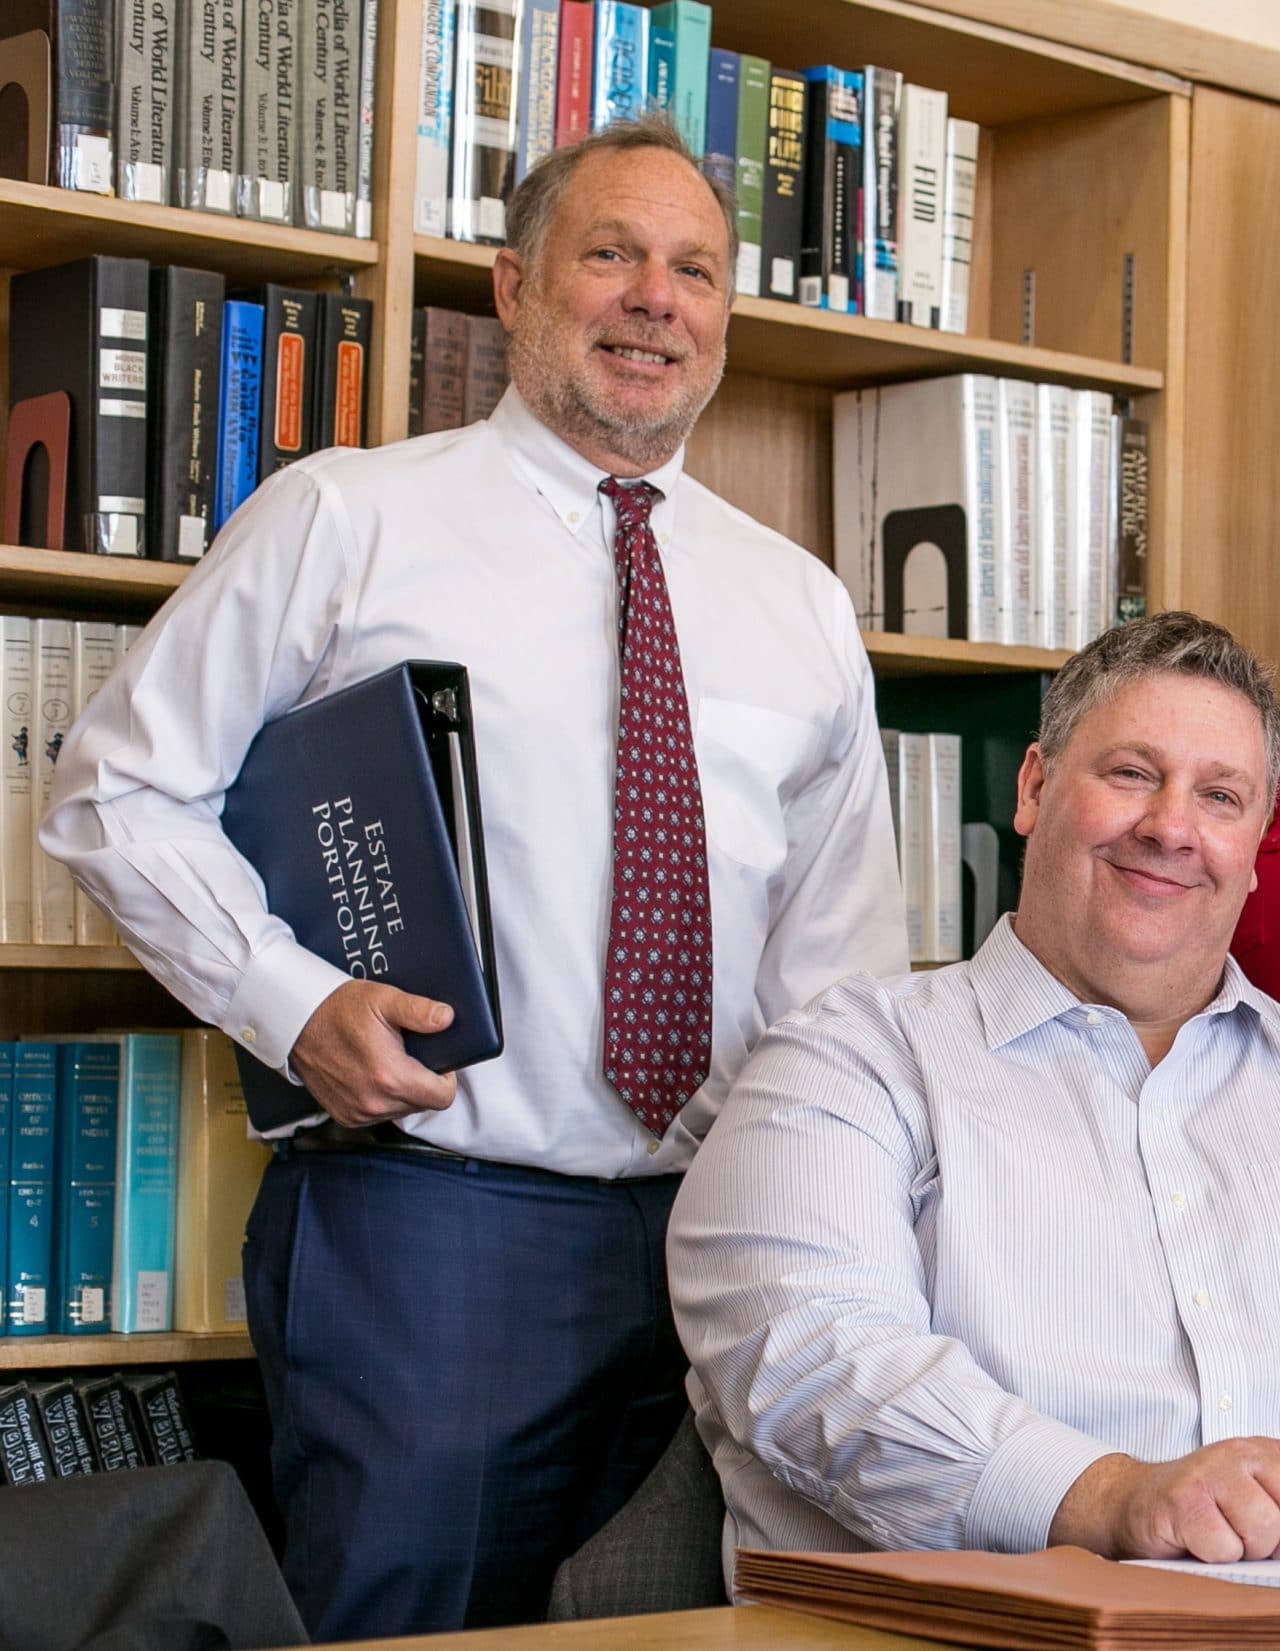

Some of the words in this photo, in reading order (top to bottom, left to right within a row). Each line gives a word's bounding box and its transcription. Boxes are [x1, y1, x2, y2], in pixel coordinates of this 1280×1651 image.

[152, 2, 168, 27] of
[223, 11, 237, 42] of
[278, 23, 292, 41] of
[312, 11, 330, 82] Century
[334, 34, 350, 55] of
[152, 28, 168, 84] World
[222, 39, 237, 91] World
[277, 44, 292, 98] World
[334, 58, 350, 109] World
[151, 86, 168, 167] Literatur
[222, 93, 236, 172] Literatur
[277, 101, 292, 183] Literatur
[334, 112, 349, 193] Literature
[102, 373, 145, 385] WRITERS
[113, 363, 145, 374] BLACK
[312, 802, 367, 979] PORTFOLIO
[334, 797, 388, 975] PLANNING
[364, 819, 404, 935] ESTATE
[0, 1401, 35, 1487] WORL
[45, 1398, 79, 1479] WORL
[92, 1393, 125, 1472] WORL
